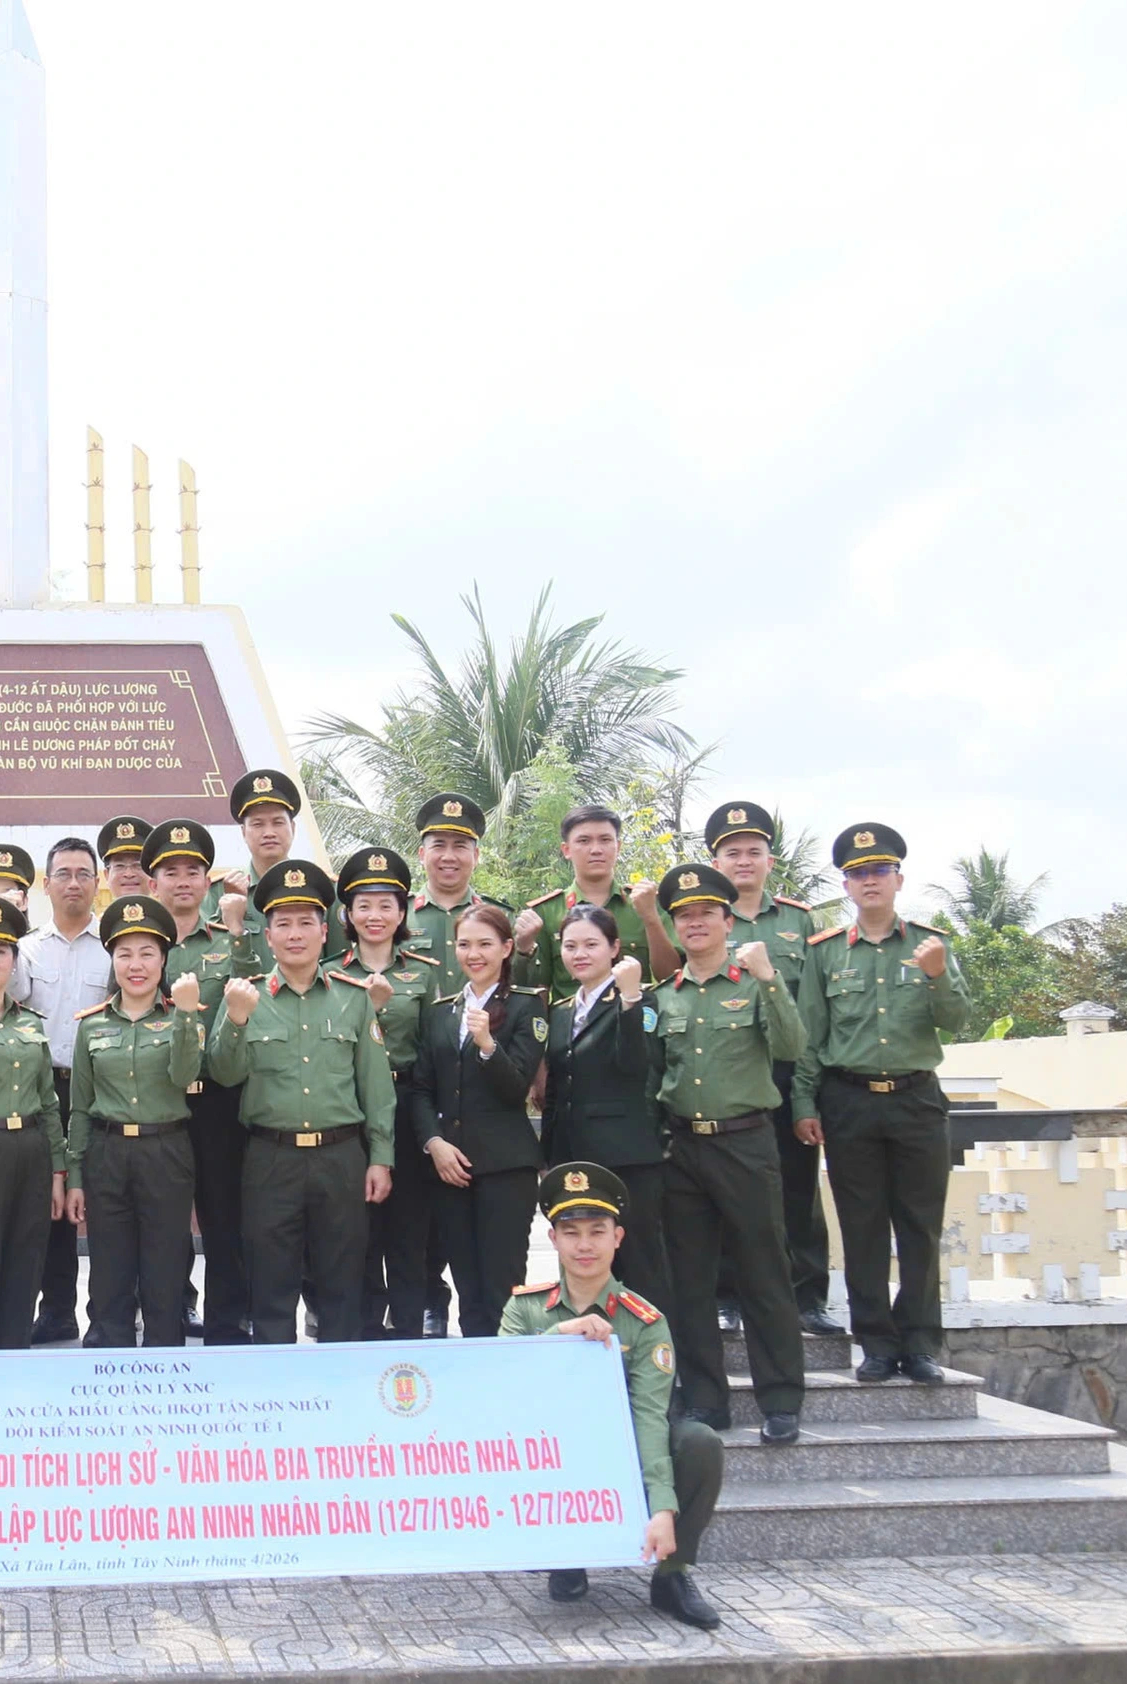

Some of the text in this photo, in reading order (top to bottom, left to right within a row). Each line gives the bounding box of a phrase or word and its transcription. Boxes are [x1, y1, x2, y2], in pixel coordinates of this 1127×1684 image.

[0, 685, 27, 697] (4-12
[31, 680, 47, 695] ẤT
[51, 682, 82, 698] DẬU)
[85, 683, 109, 697] LỰC
[114, 683, 157, 696] LƯỢNG
[0, 700, 32, 714] ĐƯỚC
[36, 700, 53, 713] ĐÃ
[57, 698, 86, 713] PHỐI
[89, 701, 114, 714] HỢP
[118, 700, 138, 713] VỚI
[142, 700, 166, 714] LỰC
[33, 718, 70, 733] GIUỘC
[74, 718, 107, 733] CHẶN
[111, 717, 144, 731] ĐÁNH
[14, 737, 28, 750] LÊ
[33, 739, 75, 750] DƯƠNG
[79, 737, 111, 750] PHÁP
[114, 736, 139, 750] ĐỐT
[142, 737, 175, 750] CHÁY
[19, 756, 36, 771] BỘ
[40, 756, 57, 769] VŨ
[62, 756, 83, 769] KHÍ
[86, 758, 112, 771] ĐẠN
[117, 757, 152, 770] DƯỢC
[156, 754, 182, 768] CỦA
[94, 1360, 191, 1377] BỘ CÔNG AN
[71, 1384, 104, 1398] CỤC
[158, 1380, 177, 1394] LÝ
[183, 1382, 215, 1394] XNC
[4, 1406, 26, 1417] AN
[168, 1403, 212, 1416] HKQT
[85, 1423, 126, 1437] SOÁT
[132, 1425, 153, 1436] AN
[158, 1423, 197, 1435] NINH
[22, 1448, 68, 1487] TÍCH
[76, 1452, 122, 1493] LỊCH
[128, 1441, 158, 1486] SỬ
[177, 1444, 220, 1483] VĂN
[226, 1443, 269, 1482] HÓA
[274, 1447, 310, 1481] BIA
[315, 1434, 396, 1479] TRUYỀN
[400, 1430, 471, 1476] THỐNG
[475, 1432, 521, 1472] NHÀ
[525, 1430, 562, 1470] DÀI
[43, 1506, 83, 1550] LỰC
[89, 1505, 160, 1548] LƯỢNG
[167, 1506, 196, 1539] AN
[202, 1505, 255, 1539] NINH
[261, 1496, 321, 1537] NHÂN
[327, 1494, 372, 1535] DÂN
[378, 1496, 490, 1535] (12/7/1946
[510, 1489, 623, 1526] 12/7/2026)
[25, 1558, 53, 1571] Tân
[131, 1556, 158, 1572] Tây
[164, 1555, 199, 1568] Ninh
[204, 1553, 246, 1569] tháng
[250, 1551, 299, 1567] 4/2026
